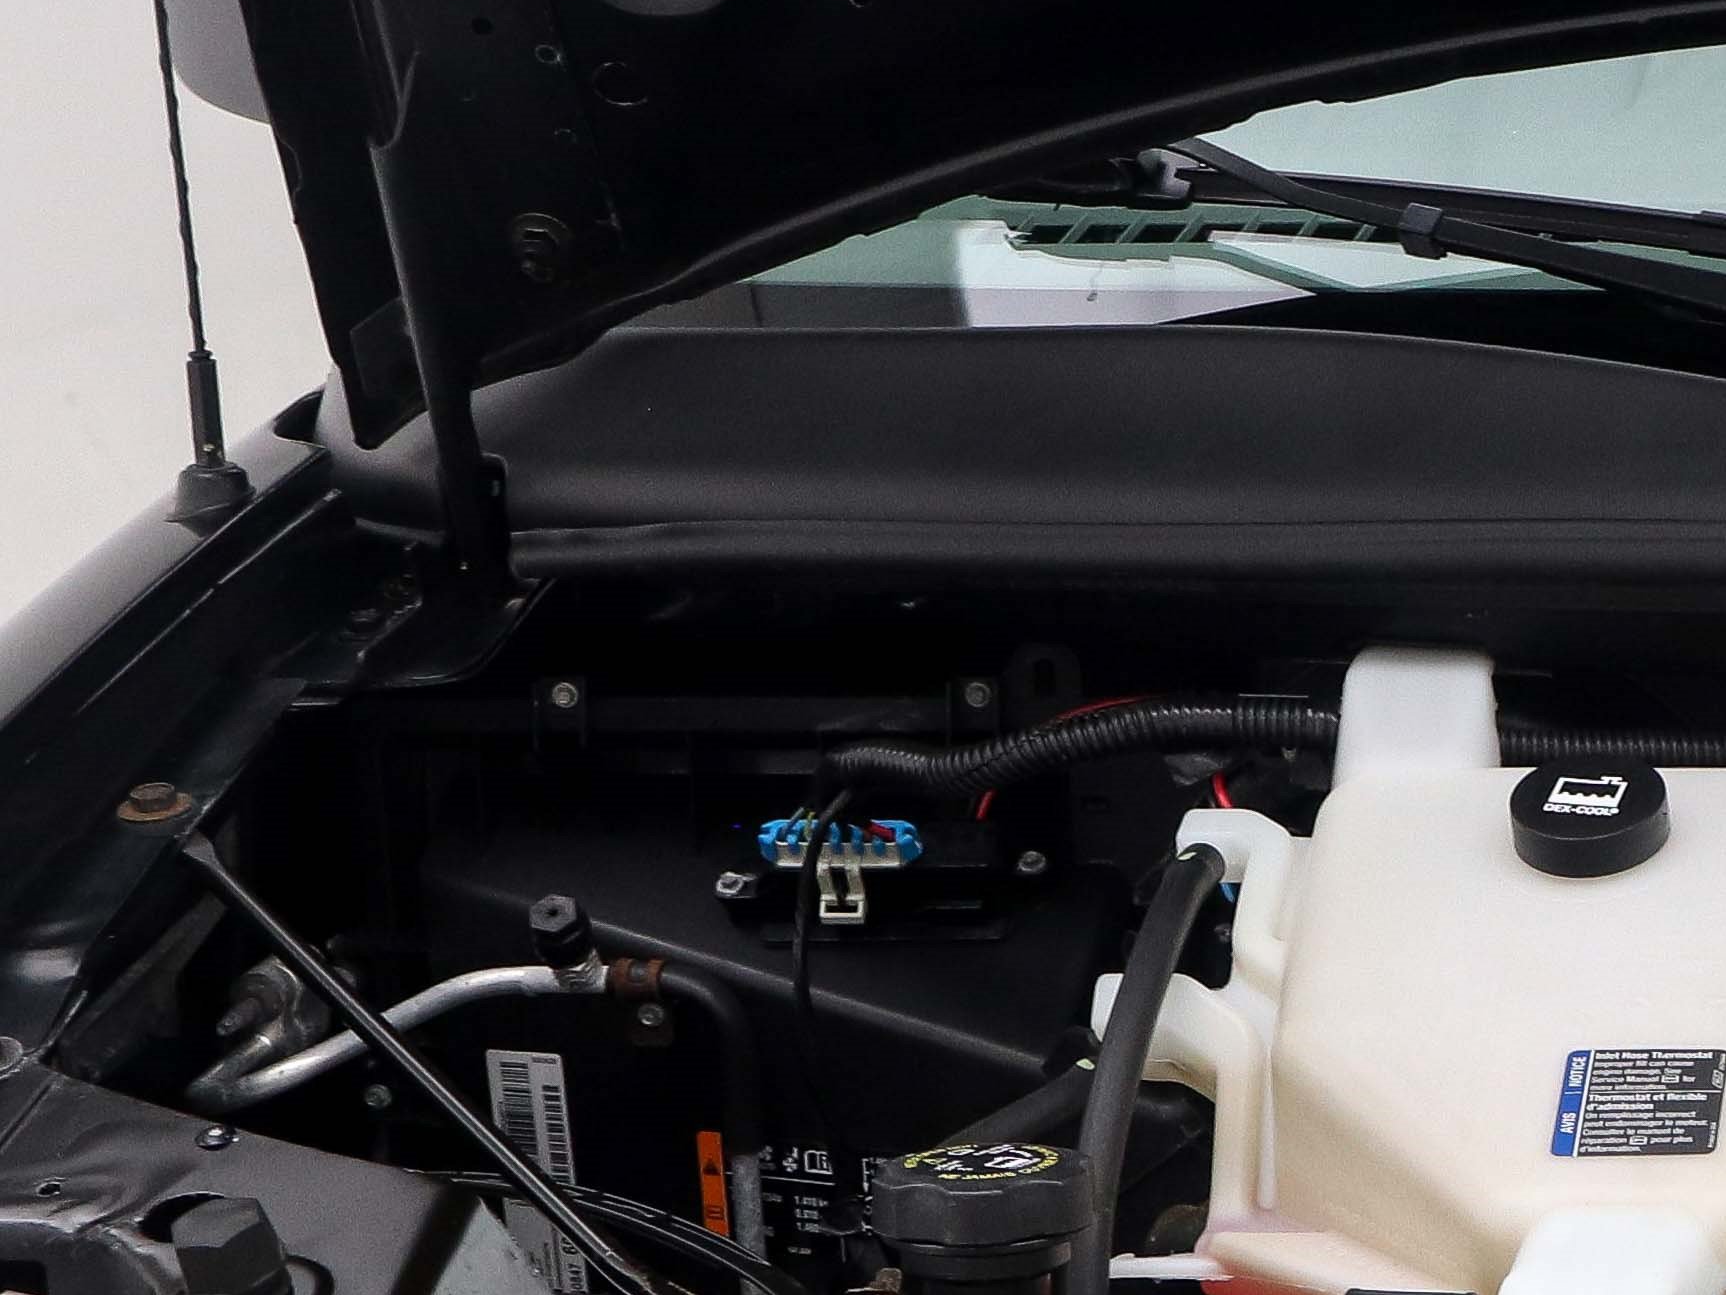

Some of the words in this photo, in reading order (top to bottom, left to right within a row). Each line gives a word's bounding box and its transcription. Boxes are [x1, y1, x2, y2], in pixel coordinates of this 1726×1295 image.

[1568, 1056, 1588, 1088] NOTICE
[1589, 1093, 1652, 1101] Thermostat
[1560, 1112, 1577, 1134] AVIS
